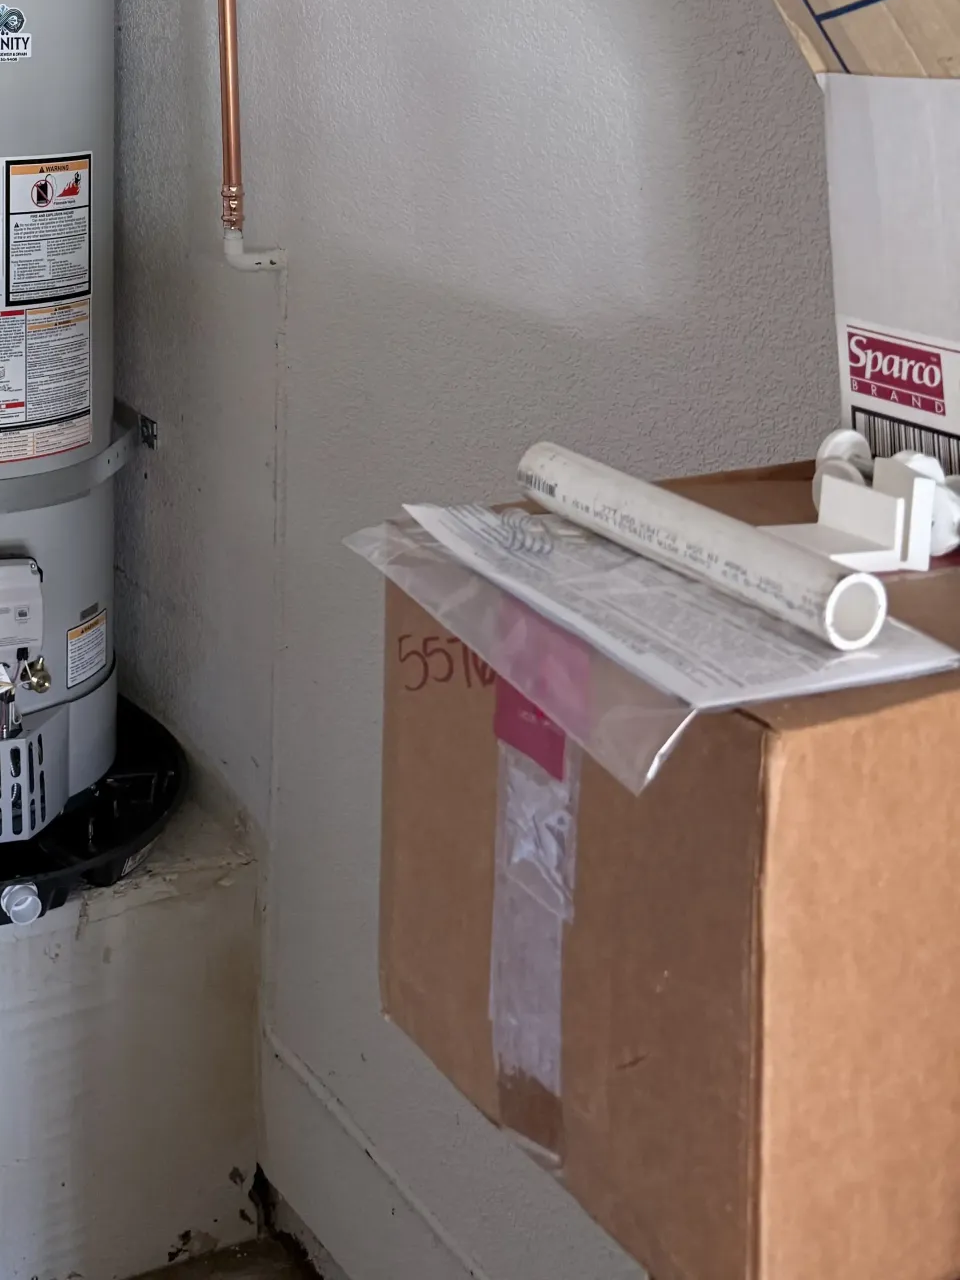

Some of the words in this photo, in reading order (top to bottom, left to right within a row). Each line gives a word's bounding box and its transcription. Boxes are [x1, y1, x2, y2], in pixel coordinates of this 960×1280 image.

[45, 164, 70, 172] WARNING
[848, 335, 941, 388] Sparco
[852, 380, 944, 413] BRAND
